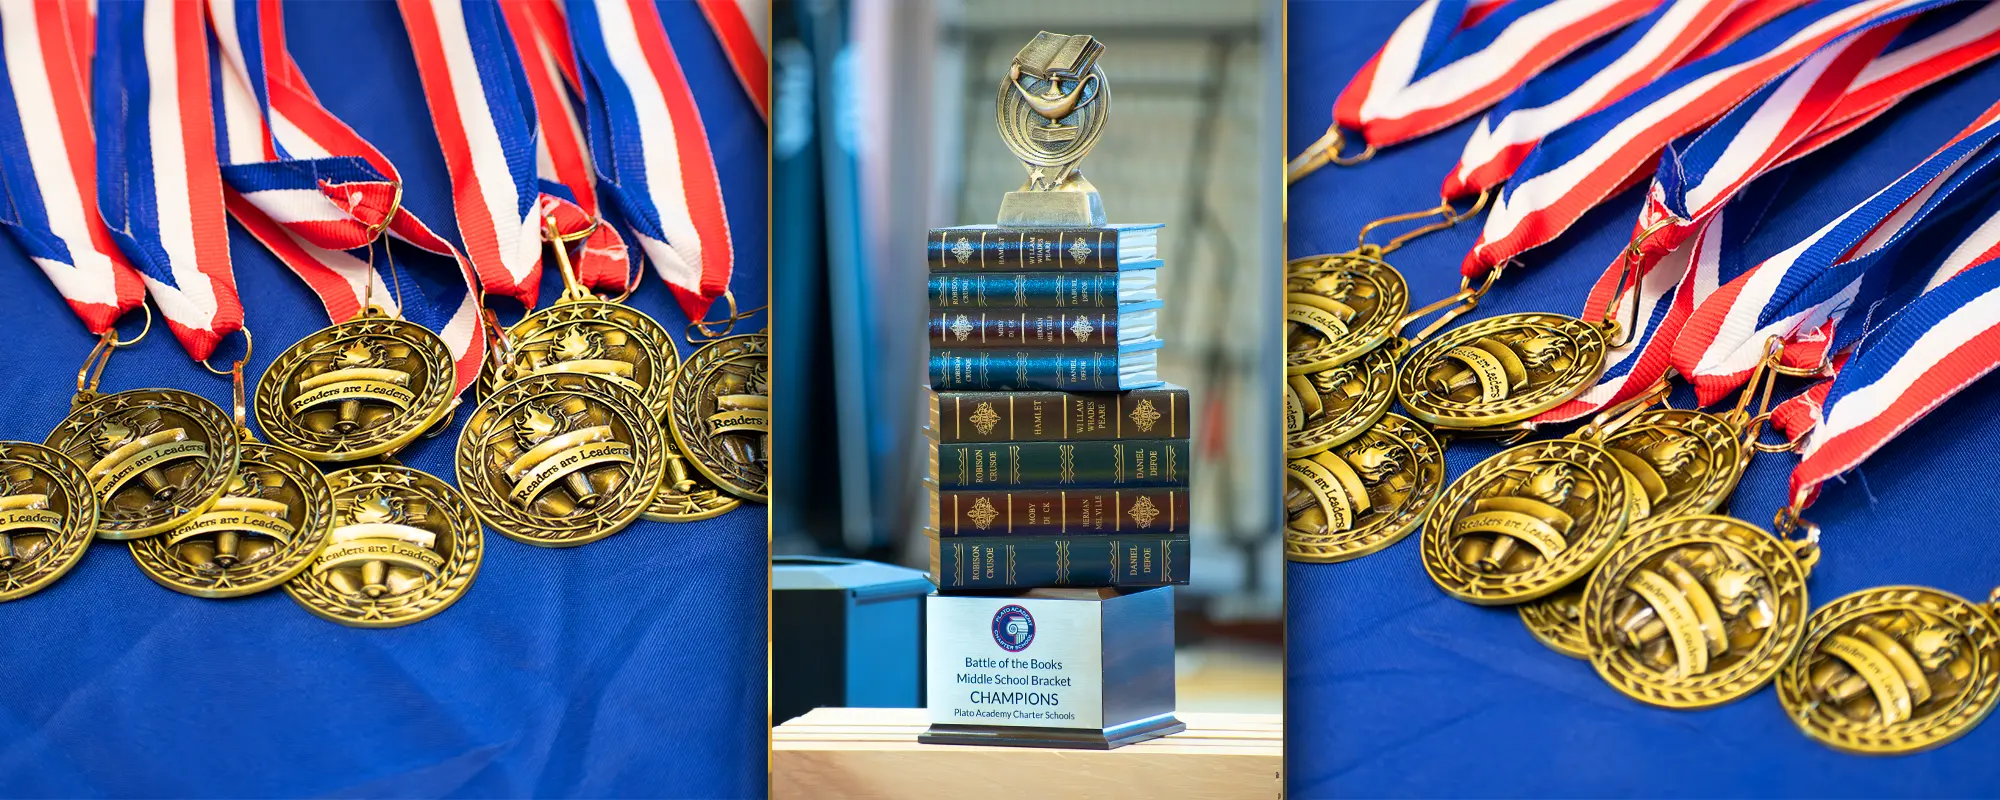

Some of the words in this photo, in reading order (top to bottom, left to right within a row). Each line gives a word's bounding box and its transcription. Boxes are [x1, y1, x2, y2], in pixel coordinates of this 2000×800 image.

[1308, 311, 1344, 336] Leaders
[1484, 366, 1502, 398] Leaders
[293, 388, 340, 410] Readers
[342, 385, 362, 393] are
[364, 384, 410, 403] Leaders
[713, 416, 763, 430] Readers
[135, 455, 154, 468] are
[154, 444, 204, 458] Leaders
[975, 450, 983, 483] ROBISON
[516, 464, 559, 501] Readers
[560, 454, 578, 468] are
[580, 446, 630, 460] Leaders
[1315, 476, 1330, 490] are
[1325, 489, 1344, 528] Leaders
[9, 514, 60, 524] Leaders
[168, 518, 216, 540] Readers
[243, 516, 290, 536] Leaders
[1458, 517, 1502, 532] Readers
[1504, 519, 1522, 529] are
[1524, 522, 1560, 550] Leaders
[316, 545, 364, 566] Readers
[368, 545, 388, 553] are
[392, 544, 440, 568] Leaders
[996, 608, 1010, 622] PLATO
[1011, 607, 1032, 626] ACADEMY
[994, 630, 1014, 650] CHARTER
[1015, 634, 1033, 650] SCHOOL
[965, 657, 996, 668] Battle
[998, 658, 1009, 668] of
[1012, 659, 1028, 669] the
[1030, 659, 1063, 670] Books
[957, 673, 992, 684] Middle
[995, 674, 1029, 686] School
[1032, 676, 1071, 686] Bracket
[970, 691, 1058, 706] CHAMPIONS
[954, 708, 974, 717] Plato
[976, 709, 1012, 719] Academy
[1013, 710, 1043, 719] Charter
[1045, 711, 1075, 720] Schools
